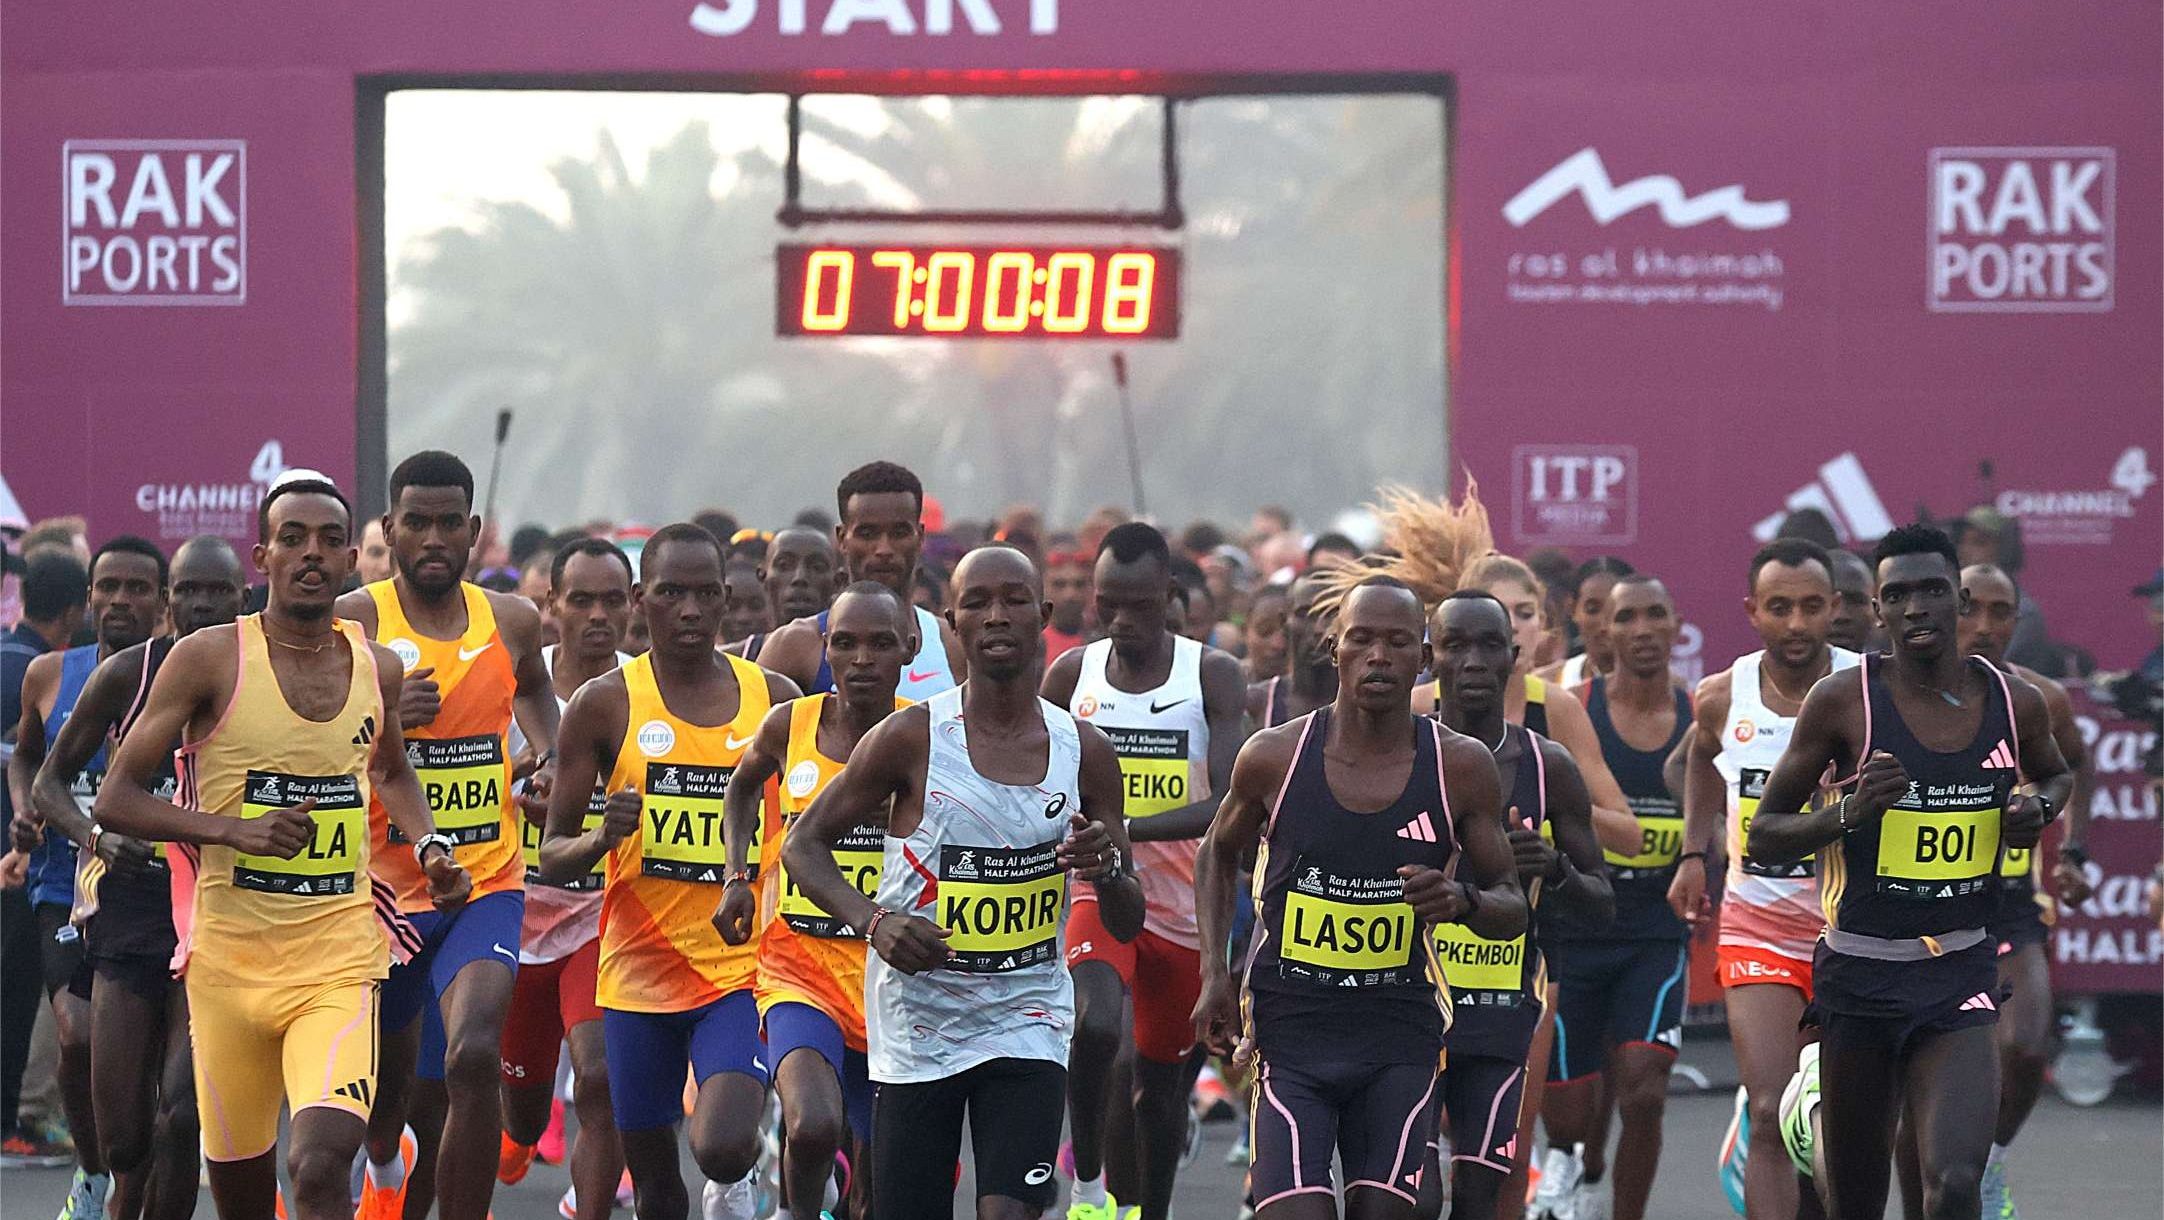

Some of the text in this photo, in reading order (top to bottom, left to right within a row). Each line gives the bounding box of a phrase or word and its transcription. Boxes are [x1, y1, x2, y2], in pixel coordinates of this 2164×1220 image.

[70, 154, 235, 228] RAK
[1935, 160, 2102, 234] RAK
[70, 236, 241, 293] PORTS
[1935, 243, 2109, 299] PORTS
[802, 250, 1155, 333] 07:00:08
[1530, 456, 1626, 502] ITP
[2110, 446, 2157, 498] 4
[1100, 702, 1115, 711] NN
[428, 745, 446, 755] Ras
[447, 744, 457, 754] Al
[429, 756, 450, 765] HALF
[451, 752, 493, 764] MARATHON
[686, 784, 709, 794] HALF
[687, 771, 705, 782] Ras
[706, 772, 718, 783] Al
[1122, 773, 1184, 800] EIKO
[426, 778, 500, 812] BABA
[1926, 799, 1949, 807] HALF
[1949, 795, 1993, 806] MARATHON
[1927, 784, 1946, 797] Ras
[1946, 785, 1957, 796] Al
[648, 807, 761, 847] YAT
[843, 837, 888, 846] MARATHO
[1915, 824, 1977, 864] BOI
[984, 848, 1057, 868] Ras Al Khaimah
[984, 861, 1056, 878] HALF MARATHON
[1328, 875, 1405, 889] Ras Al Khaimah
[1328, 887, 1403, 899] HALF MARATHON
[945, 888, 1060, 936] KORIR
[1293, 907, 1406, 954] LASOI
[976, 958, 991, 968] ITP
[1437, 939, 1520, 965] PKEMBOI
